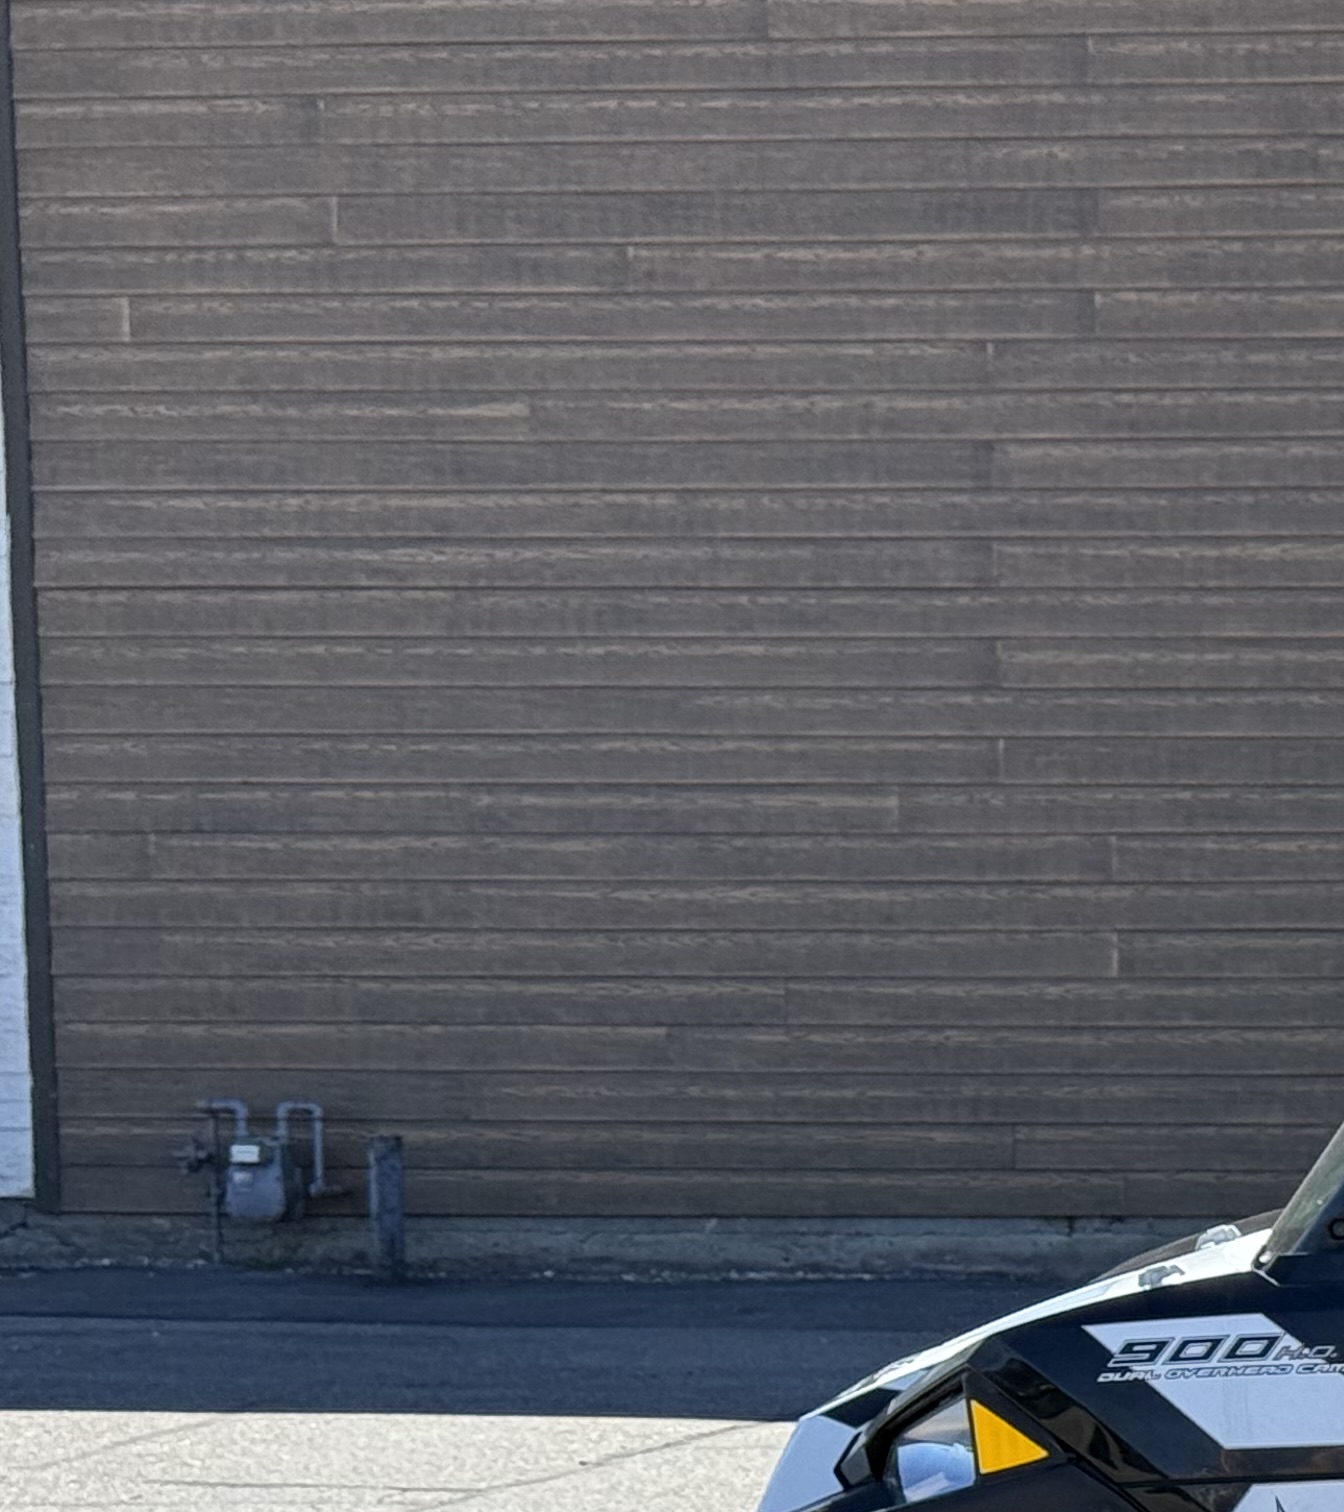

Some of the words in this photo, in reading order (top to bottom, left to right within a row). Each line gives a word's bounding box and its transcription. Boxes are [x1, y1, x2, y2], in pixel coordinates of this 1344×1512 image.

[1107, 1331, 1288, 1368] 900
[1096, 1370, 1162, 1383] DUAL
[1164, 1363, 1294, 1381] OVERHEAD
